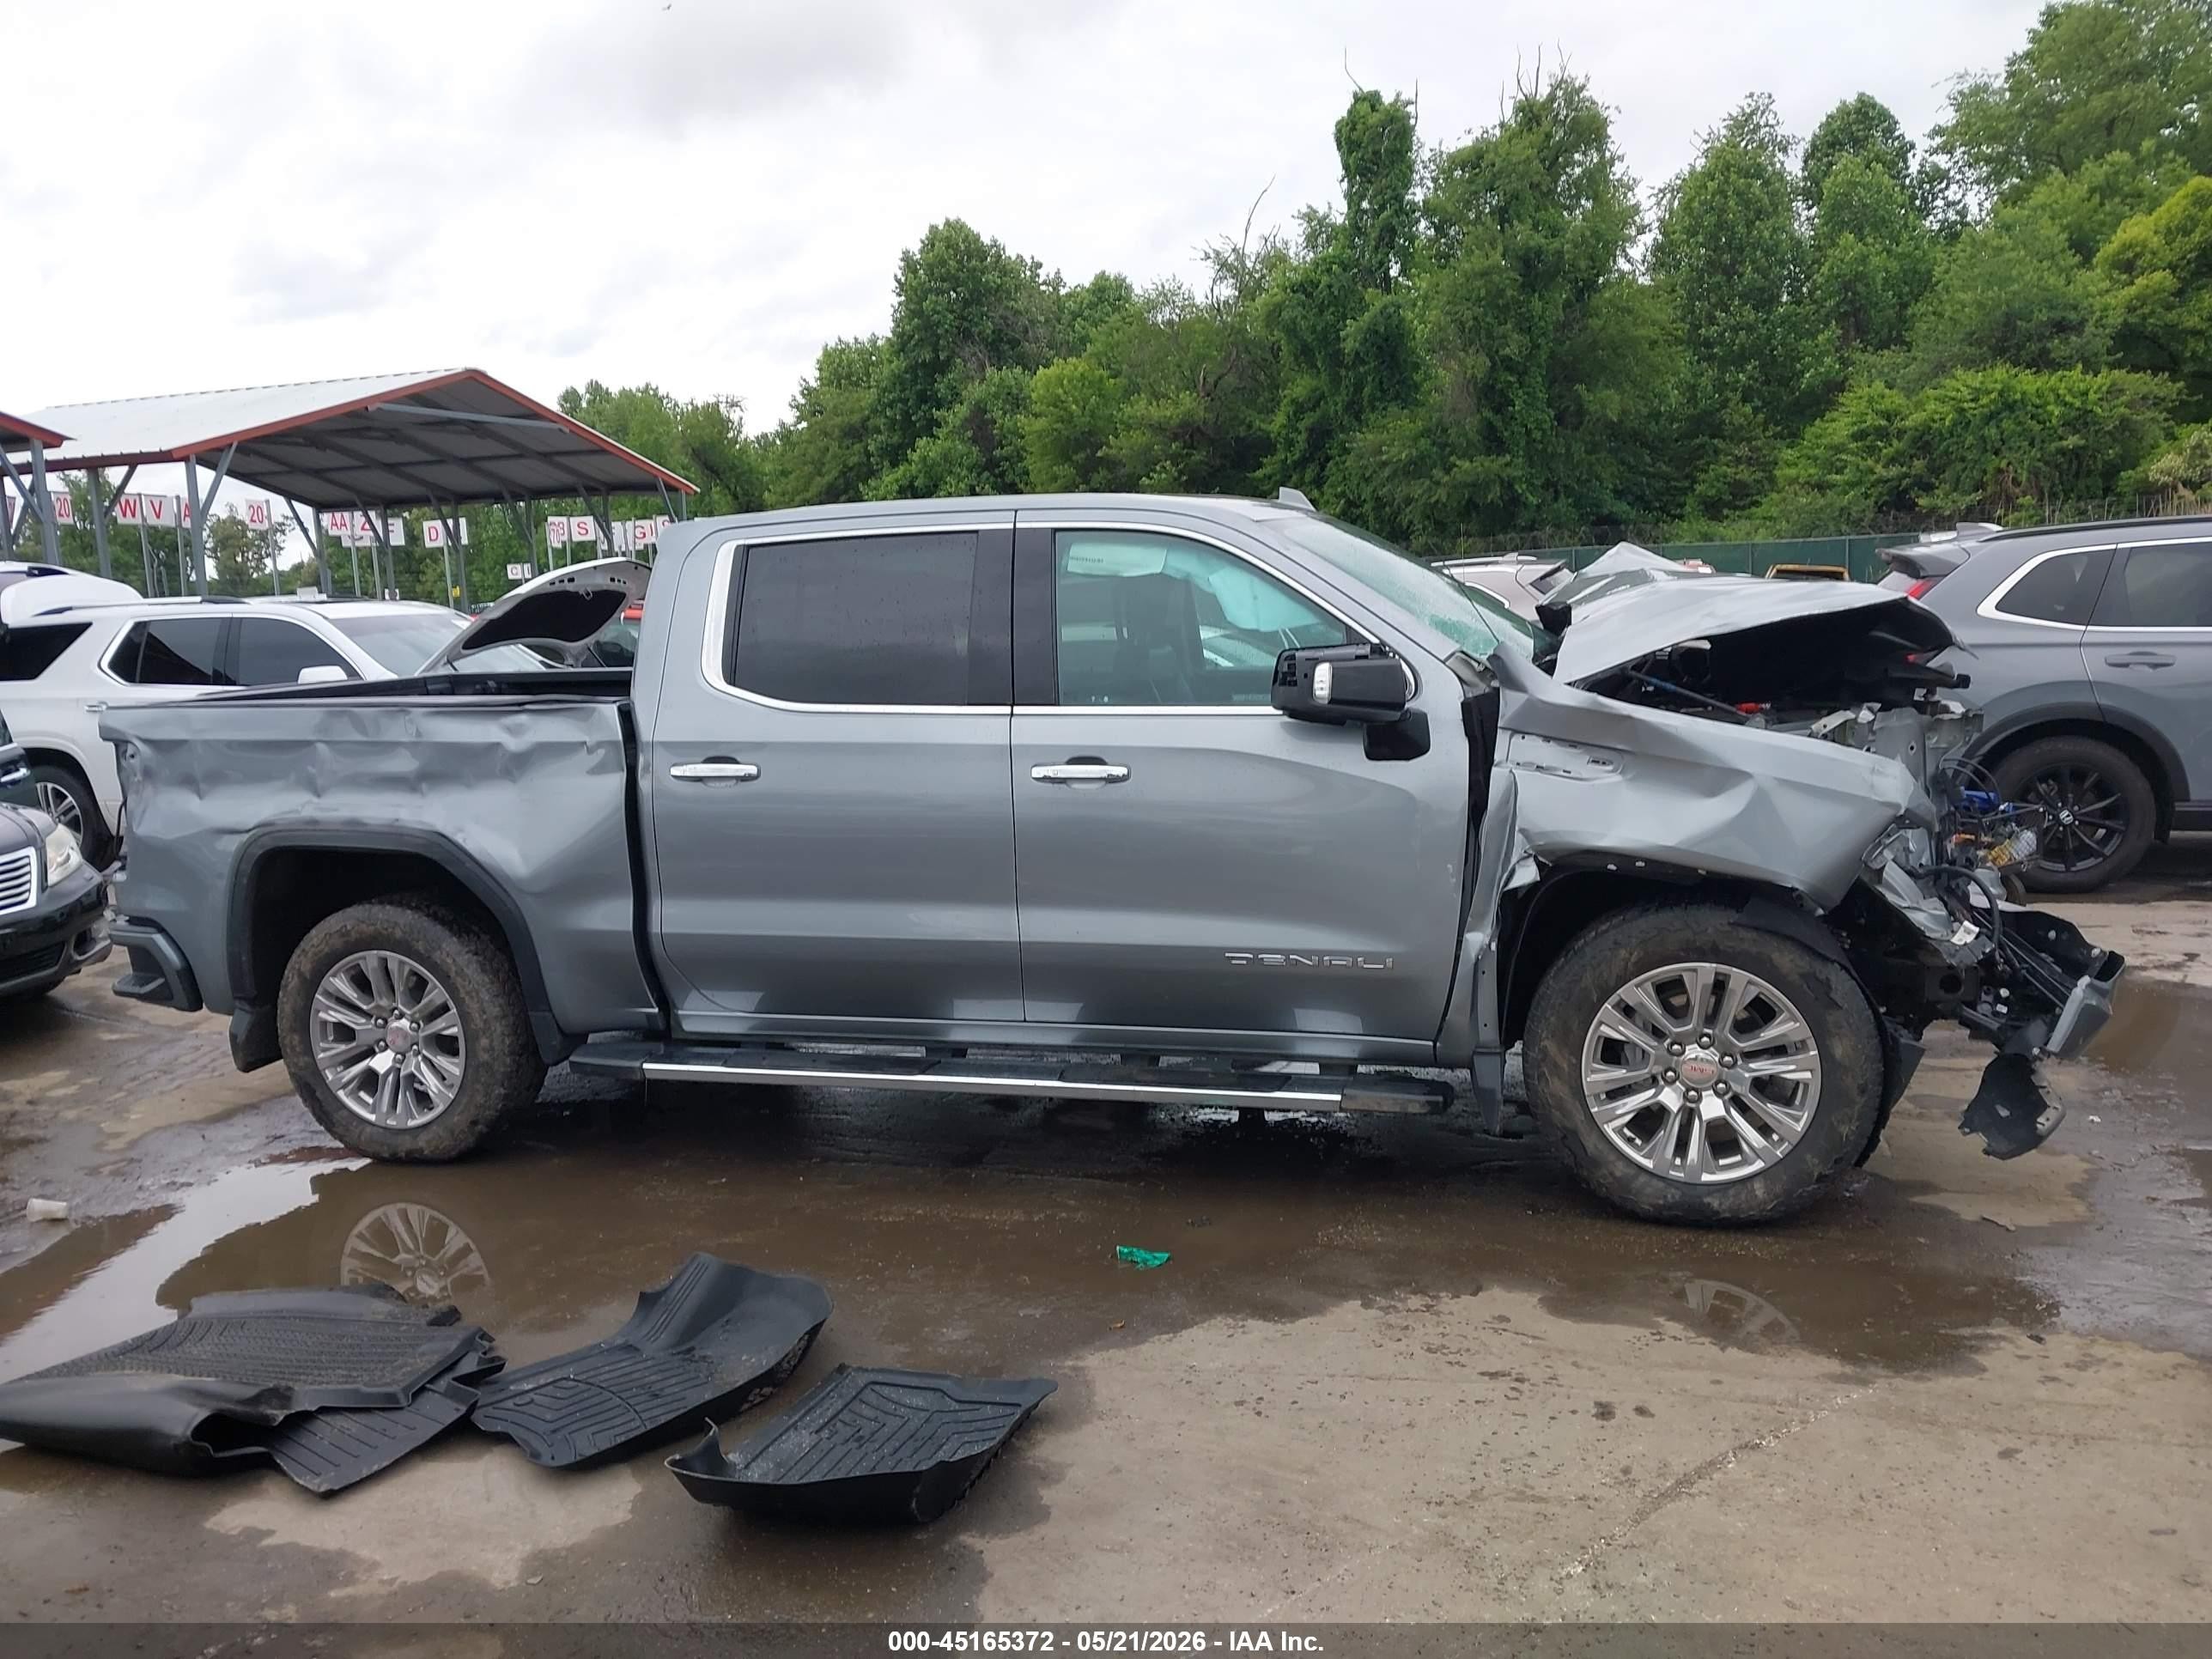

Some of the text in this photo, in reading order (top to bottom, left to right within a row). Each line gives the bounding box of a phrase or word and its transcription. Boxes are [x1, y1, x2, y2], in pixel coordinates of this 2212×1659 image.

[56, 497, 70, 518] 20
[118, 498, 137, 519] W
[149, 500, 162, 520] V
[248, 504, 264, 524] 20
[330, 513, 348, 531] AA
[576, 521, 588, 536] S
[428, 526, 439, 542] D
[1224, 951, 1395, 969] DENALI
